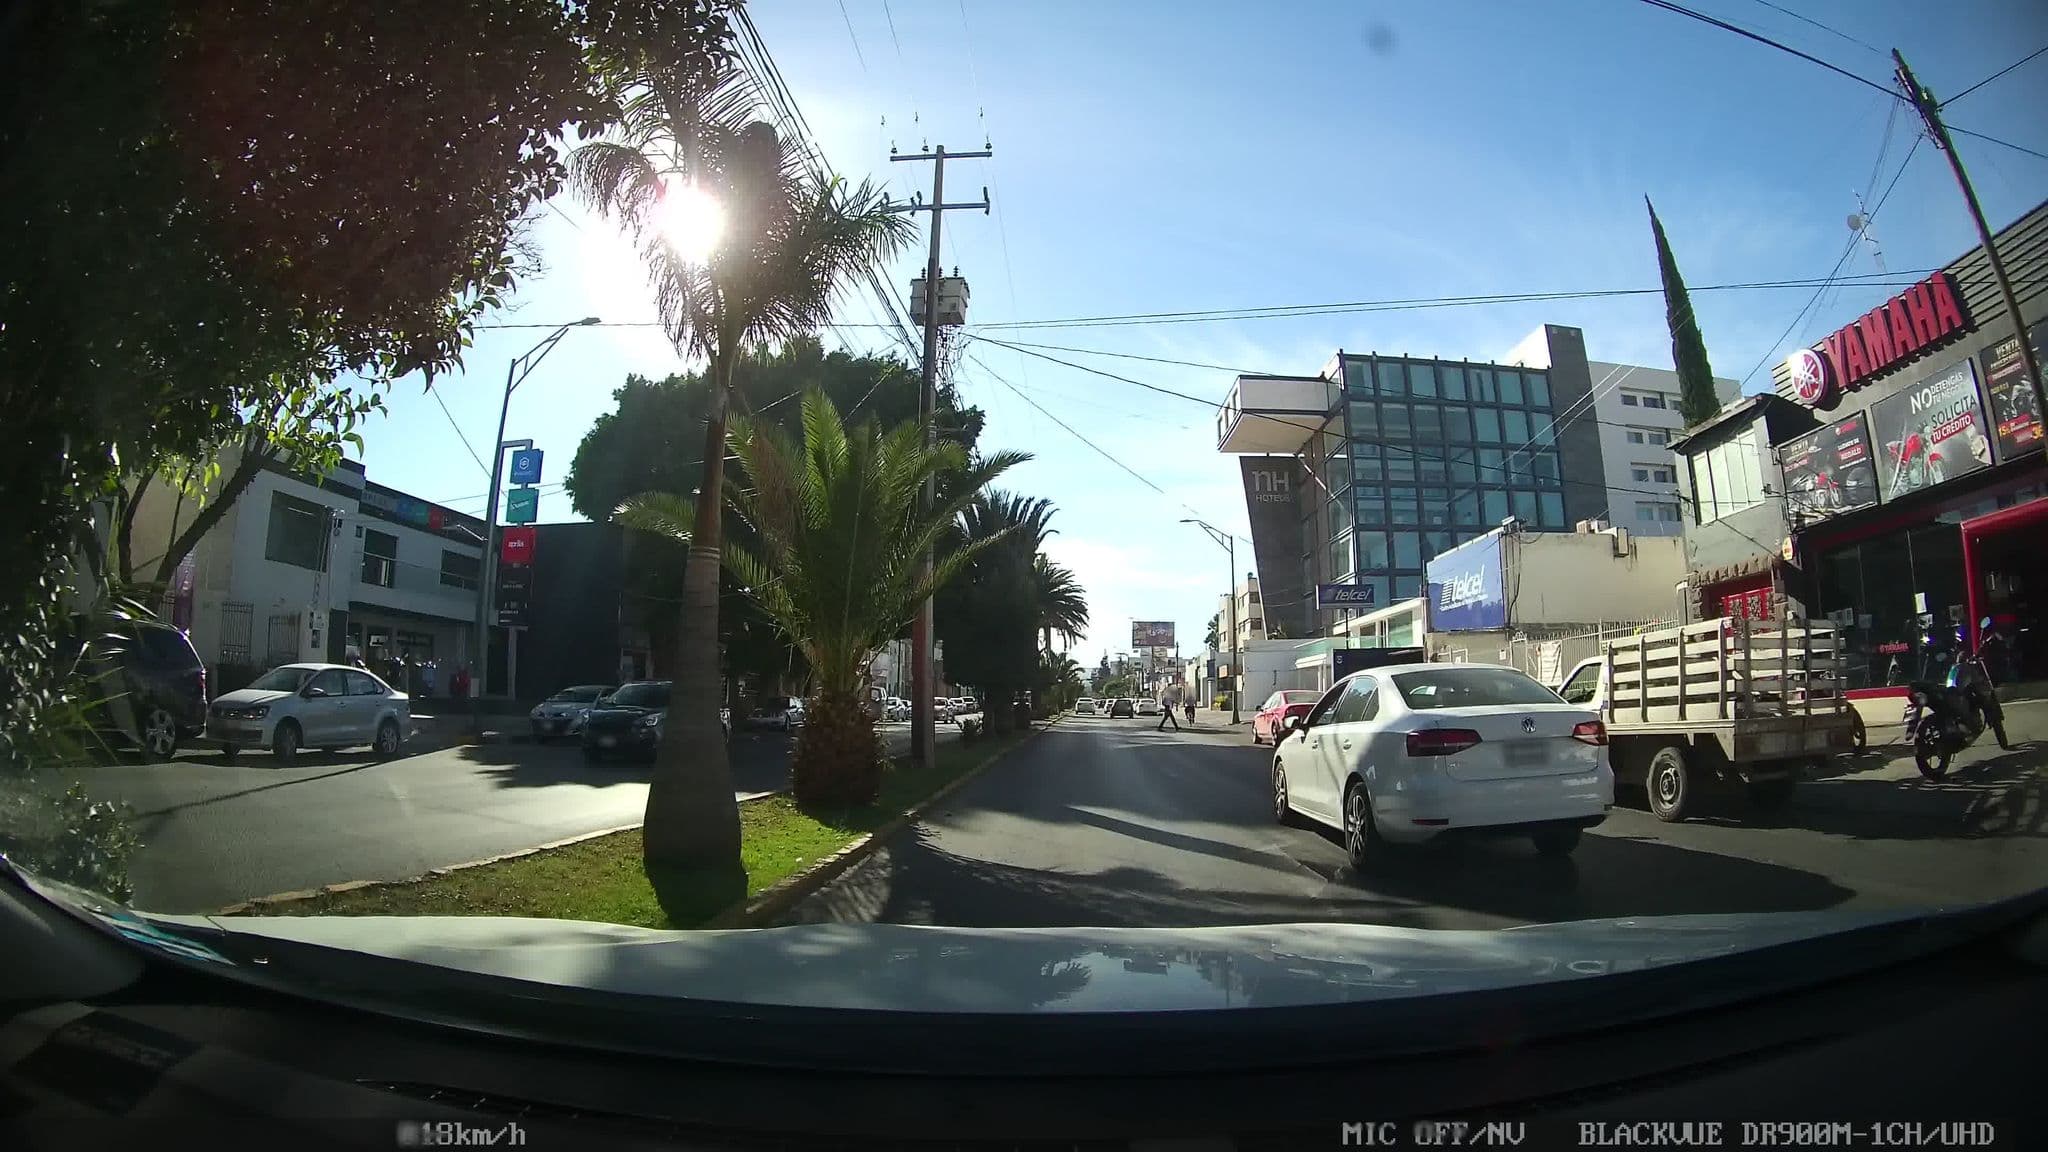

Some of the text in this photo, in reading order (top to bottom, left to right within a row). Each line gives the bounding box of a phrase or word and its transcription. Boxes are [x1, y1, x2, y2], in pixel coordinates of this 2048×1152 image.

[1823, 270, 1963, 388] YAMAHA
[1909, 387, 1932, 415] NO
[1931, 393, 1977, 429] SOLICITA
[1932, 429, 1942, 443] TU
[1334, 588, 1371, 602] telcel
[1452, 564, 1486, 603] telcel
